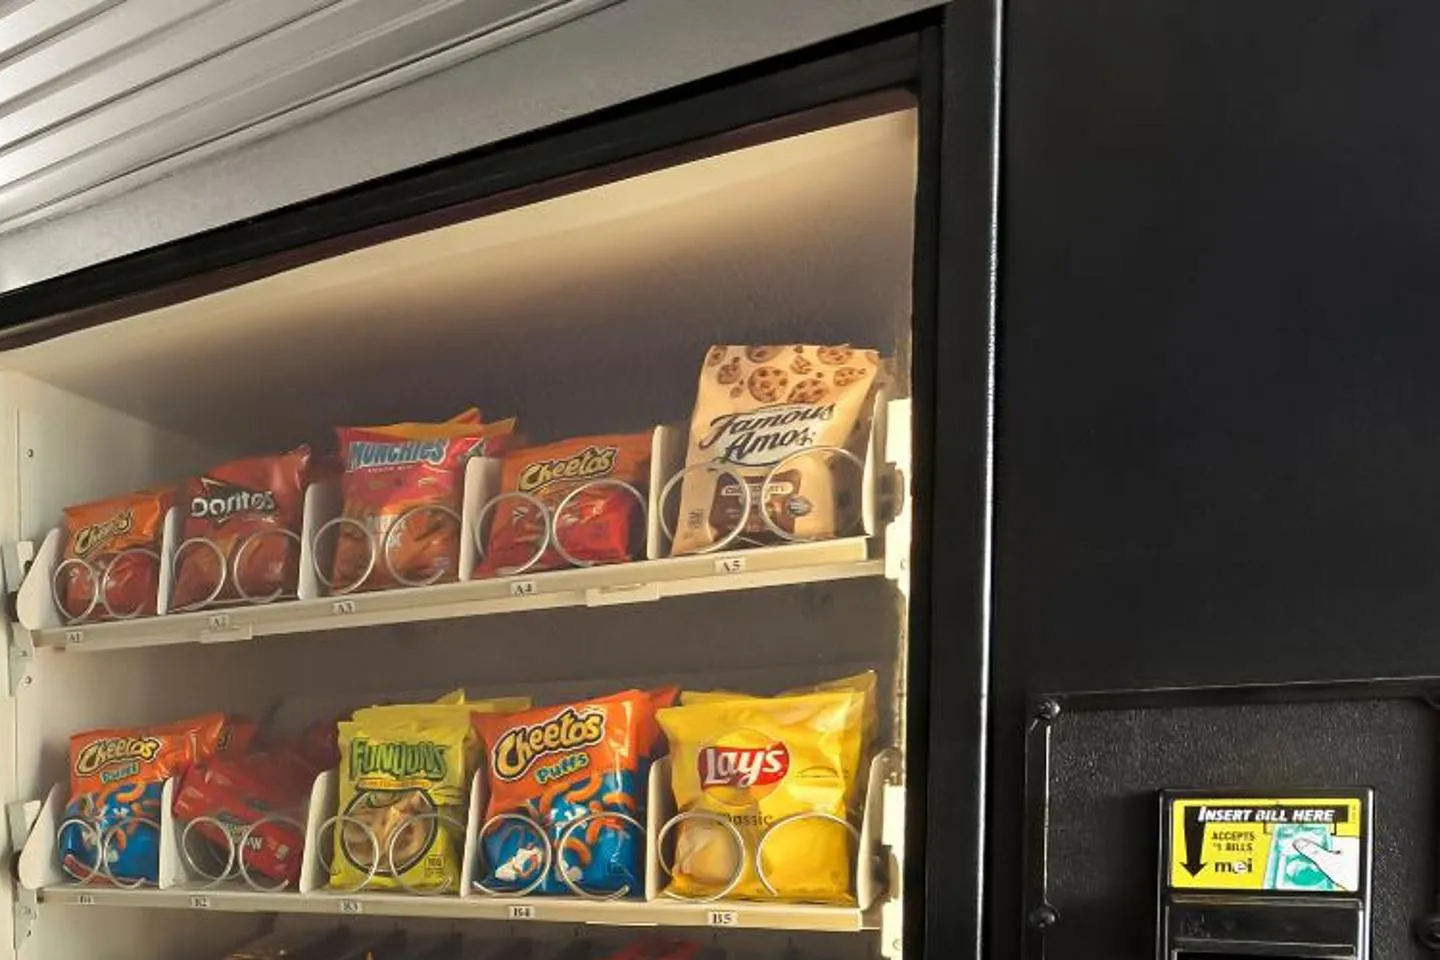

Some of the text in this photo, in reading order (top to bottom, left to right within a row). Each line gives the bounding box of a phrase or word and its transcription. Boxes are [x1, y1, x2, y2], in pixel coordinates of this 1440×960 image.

[700, 403, 836, 450] Famous
[349, 440, 447, 469] MUNCHIES
[726, 428, 809, 459] Amos
[519, 447, 617, 492] Cheetos
[191, 490, 276, 517] Doritos
[76, 737, 160, 775] Cheetos
[494, 708, 605, 780] Cheetos
[349, 738, 447, 782] FUNYUNS
[703, 742, 787, 787] Lay's
[1198, 806, 1336, 822] INSERT BILL HERE
[1211, 830, 1256, 841] ACCEPTS
[1225, 842, 1254, 852] BILLS
[1214, 858, 1253, 873] mei
